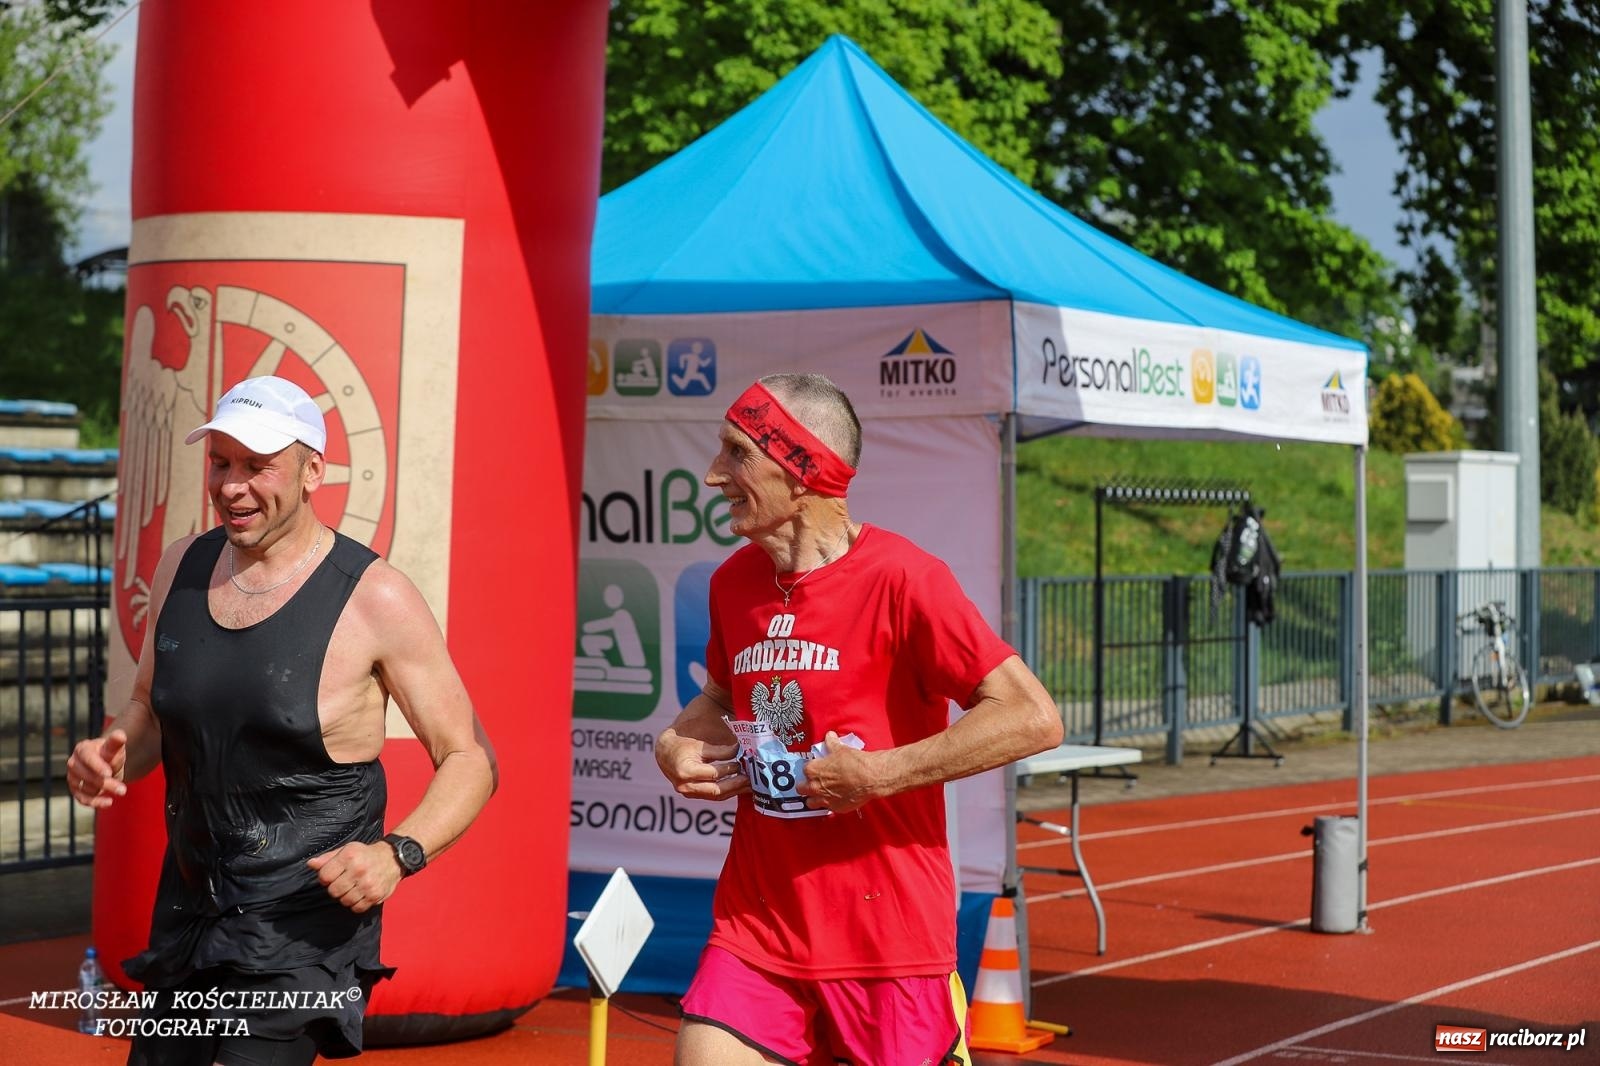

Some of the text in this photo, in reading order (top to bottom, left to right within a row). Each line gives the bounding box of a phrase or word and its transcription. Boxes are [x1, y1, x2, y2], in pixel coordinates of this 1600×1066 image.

[880, 358, 957, 385] MITKO
[1042, 338, 1185, 397] PersonalBest
[230, 397, 263, 409] KIPRUN
[767, 613, 796, 638] OD
[733, 639, 840, 676] URODZENIA
[733, 723, 748, 734] BIE
[573, 757, 632, 780] MASAŻ
